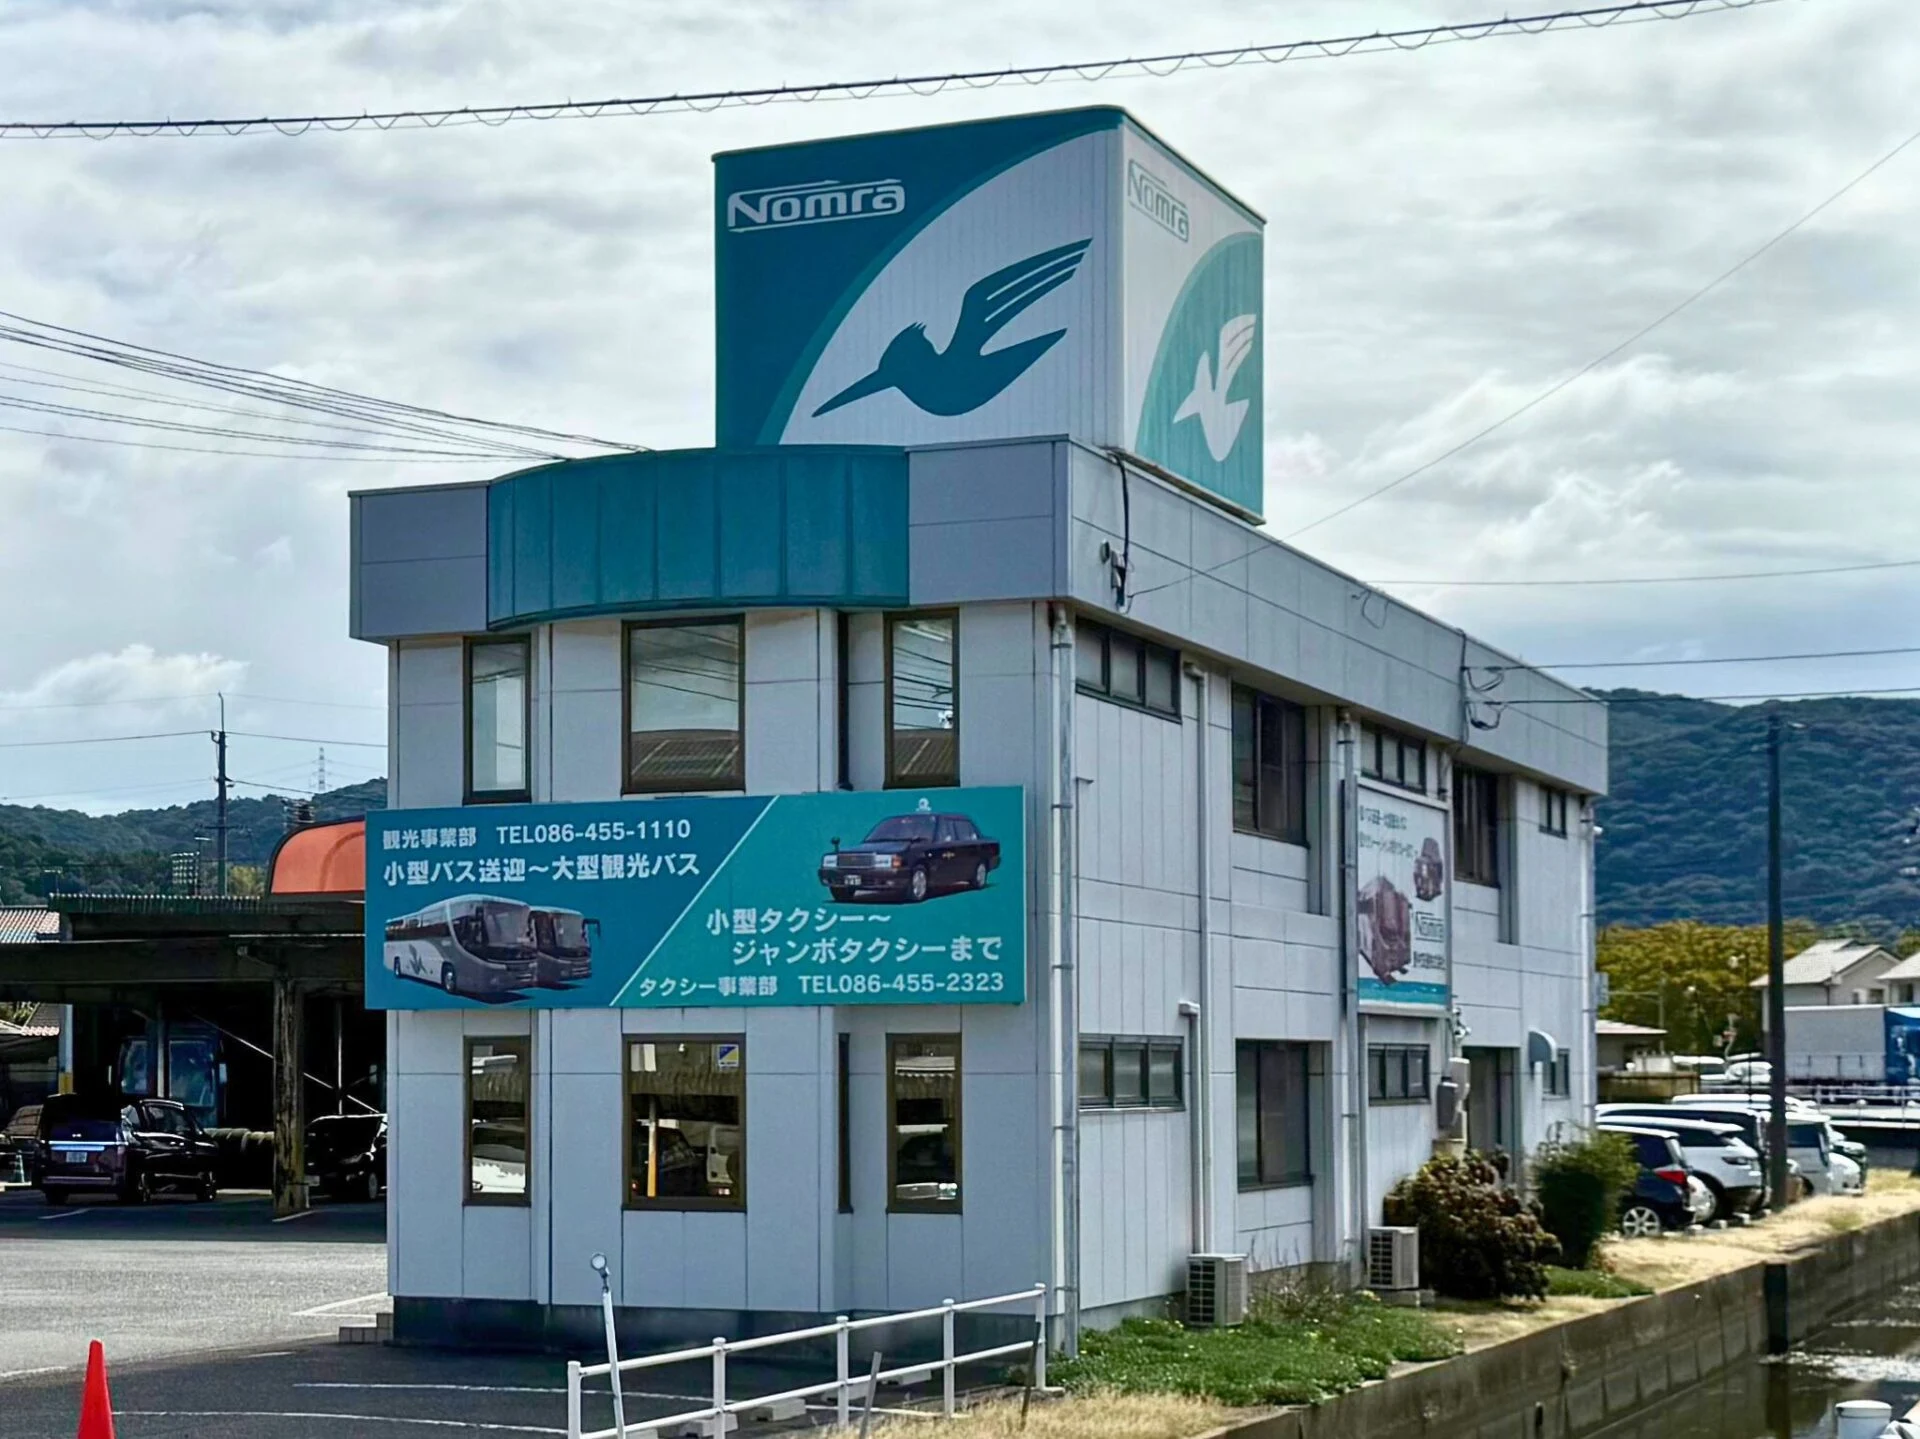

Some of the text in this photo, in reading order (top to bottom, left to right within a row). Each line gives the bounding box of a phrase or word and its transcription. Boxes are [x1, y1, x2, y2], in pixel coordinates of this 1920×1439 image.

[727, 178, 905, 233] Nomra
[1127, 159, 1188, 243] Nomra
[383, 819, 692, 850] 観光事業部 TEL086-455-1110
[732, 935, 1003, 966] ジャンボタクシーまで
[639, 972, 1004, 998] タクシー事業部 TEL086-455-2323
